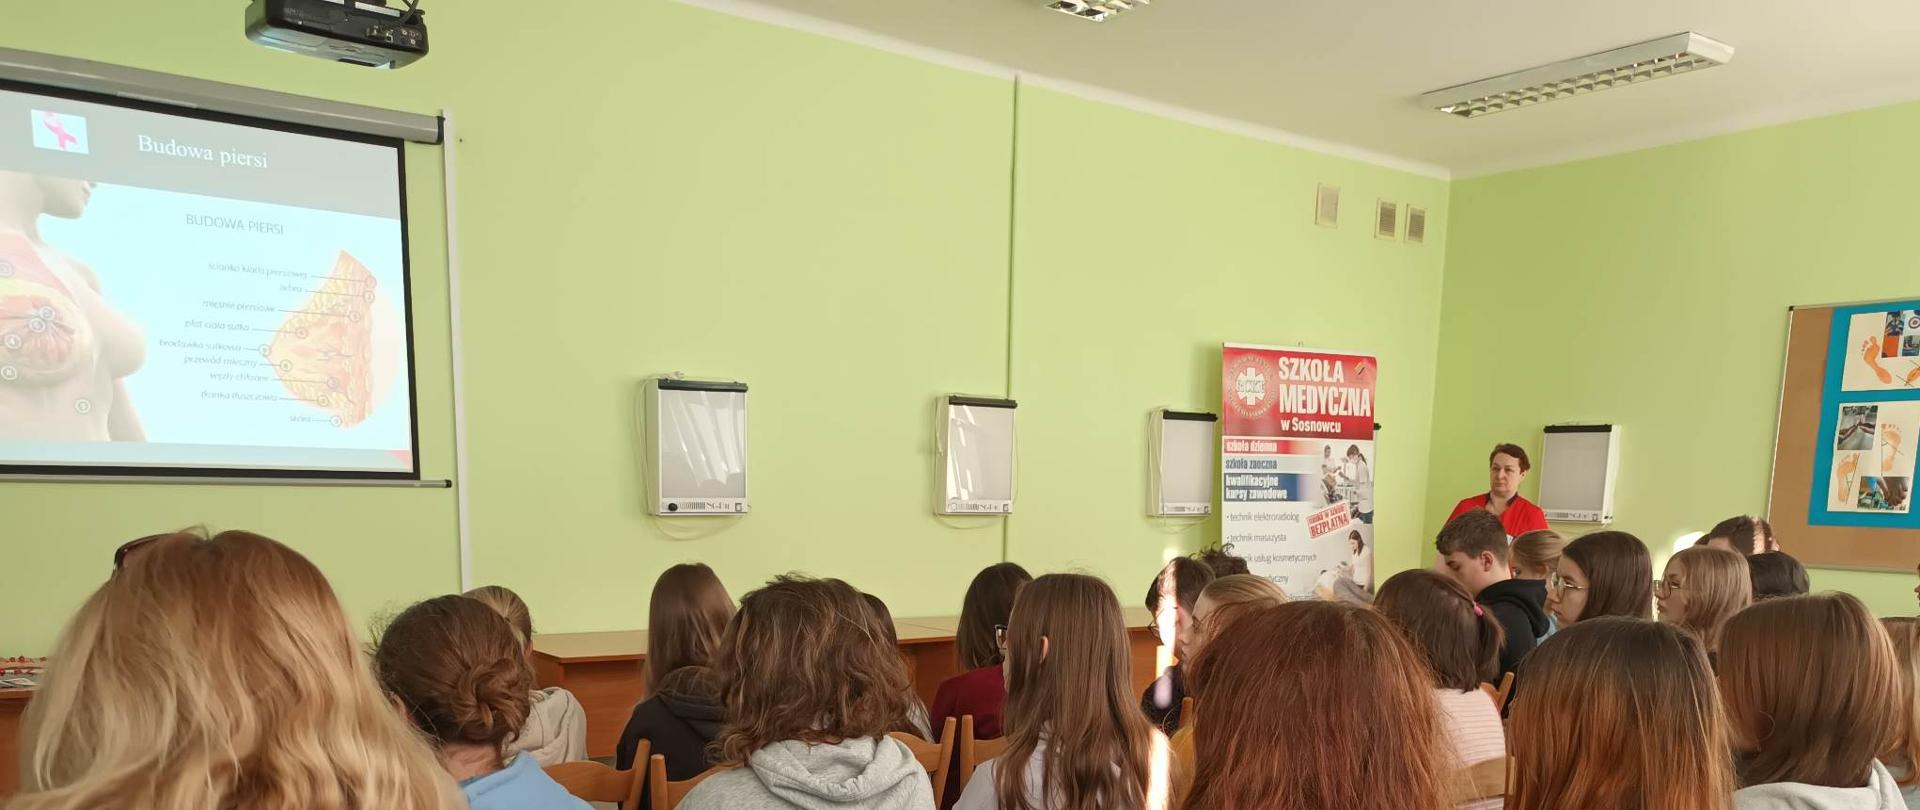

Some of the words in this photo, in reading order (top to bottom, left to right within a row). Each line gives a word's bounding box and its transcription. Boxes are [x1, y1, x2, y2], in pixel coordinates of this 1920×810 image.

[138, 135, 213, 161] Budowa
[220, 149, 267, 168] piersi
[186, 214, 245, 231] BUDOWA
[249, 222, 284, 235] PIERSI
[1279, 356, 1344, 383] SZKOŁA
[1279, 383, 1371, 417] MEDYCZNA
[1281, 420, 1290, 431] w
[1292, 416, 1341, 433] Sosnowcu
[1226, 440, 1249, 452] szkoła
[1250, 440, 1278, 453] dzienna
[1225, 458, 1248, 469] szkoła
[1250, 460, 1277, 469] zaoczna
[1225, 474, 1279, 488] kwalifikacyjne
[1225, 487, 1248, 501] kursy
[1249, 488, 1287, 500] zawodowe
[1230, 512, 1252, 521] technik
[1254, 512, 1300, 523] elektroradiolog
[1230, 533, 1252, 542] technik
[1273, 552, 1317, 564] kosmetycznych
